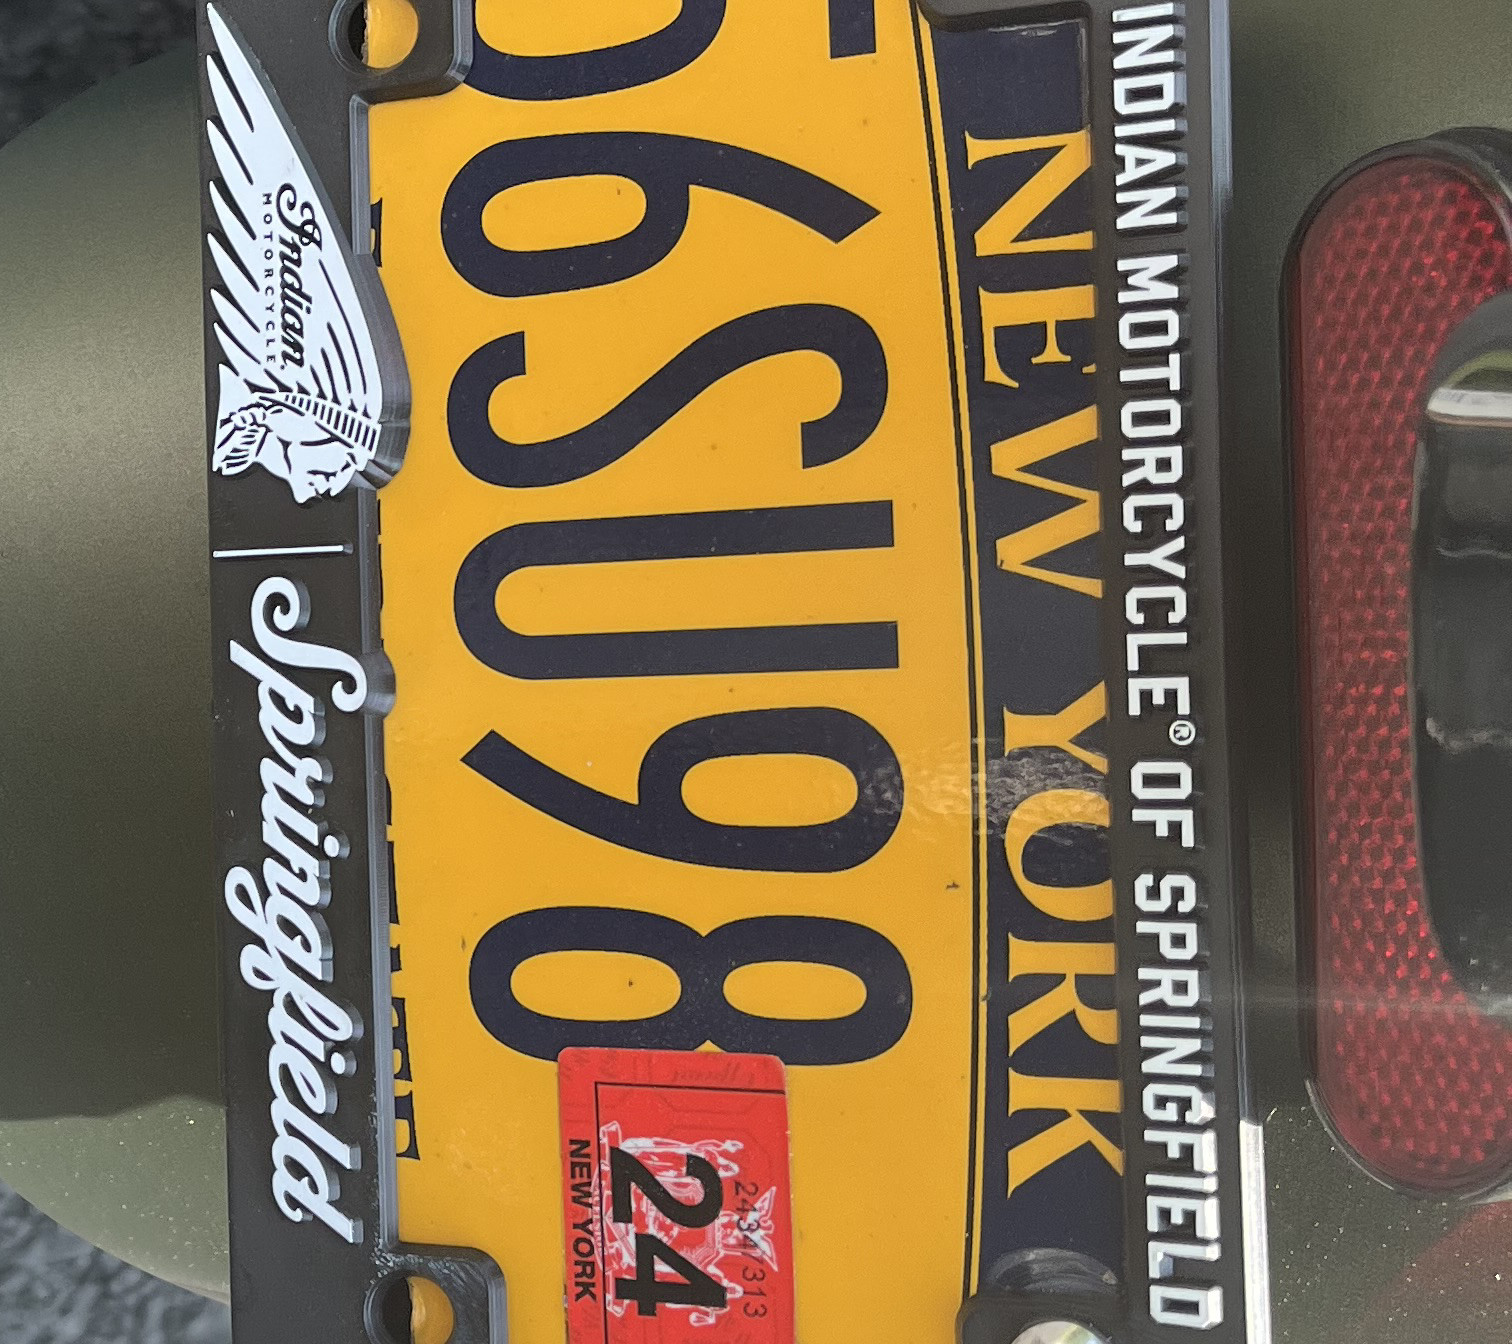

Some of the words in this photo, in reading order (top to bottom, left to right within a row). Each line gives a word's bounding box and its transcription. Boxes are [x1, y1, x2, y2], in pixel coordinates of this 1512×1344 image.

[1110, 3, 1178, 231] INDIAN
[261, 192, 275, 363] MOTORCYCLE
[964, 125, 1101, 598] NEW
[1129, 761, 1193, 847] OF
[223, 576, 366, 1244] Springfield
[1003, 681, 1123, 1198] YORK
[568, 1139, 591, 1208] NEW
[1132, 874, 1213, 1329] SPRINGFIELD
[571, 1218, 595, 1302] YORK
[609, 1146, 726, 1317] 24
